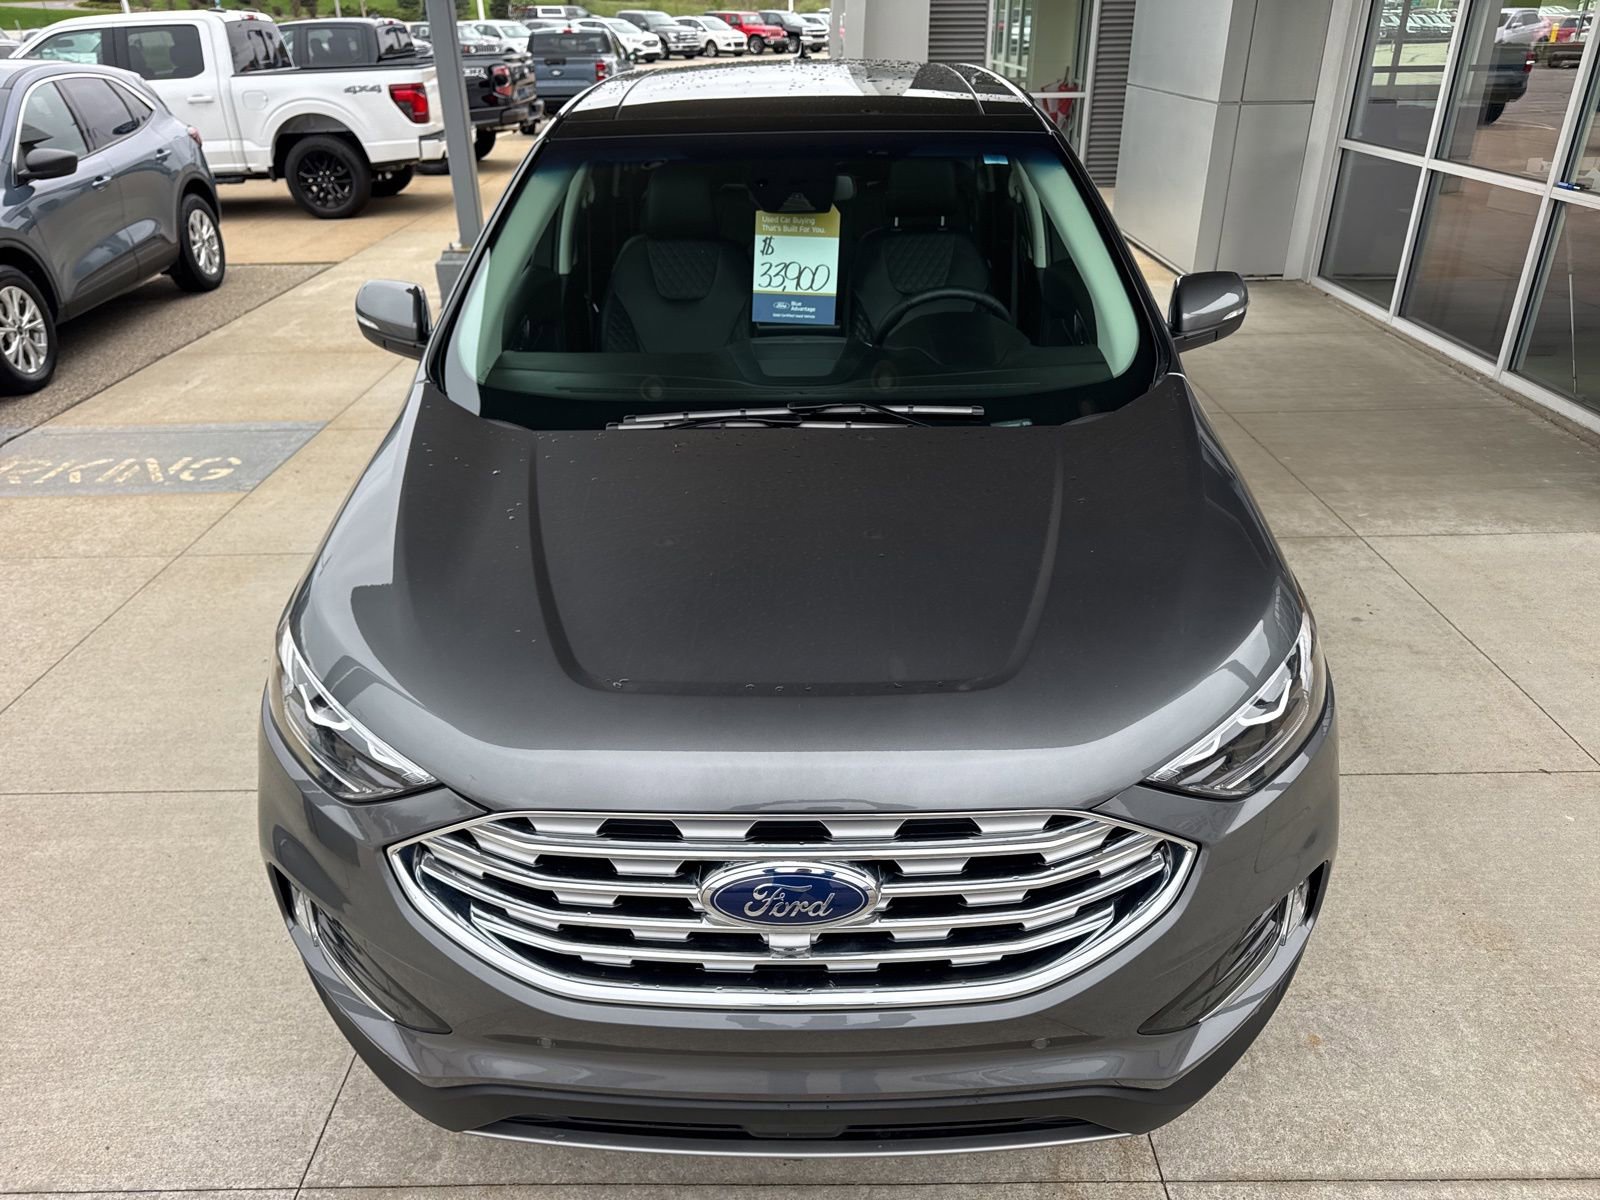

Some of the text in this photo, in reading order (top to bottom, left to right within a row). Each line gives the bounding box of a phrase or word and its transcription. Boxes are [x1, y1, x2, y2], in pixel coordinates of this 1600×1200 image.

[761, 216, 816, 226] Used Car Buying
[762, 224, 781, 232] That's
[783, 225, 799, 233] Built
[760, 236, 775, 256] $
[758, 261, 831, 292] 33,900
[743, 883, 835, 918] Ford
